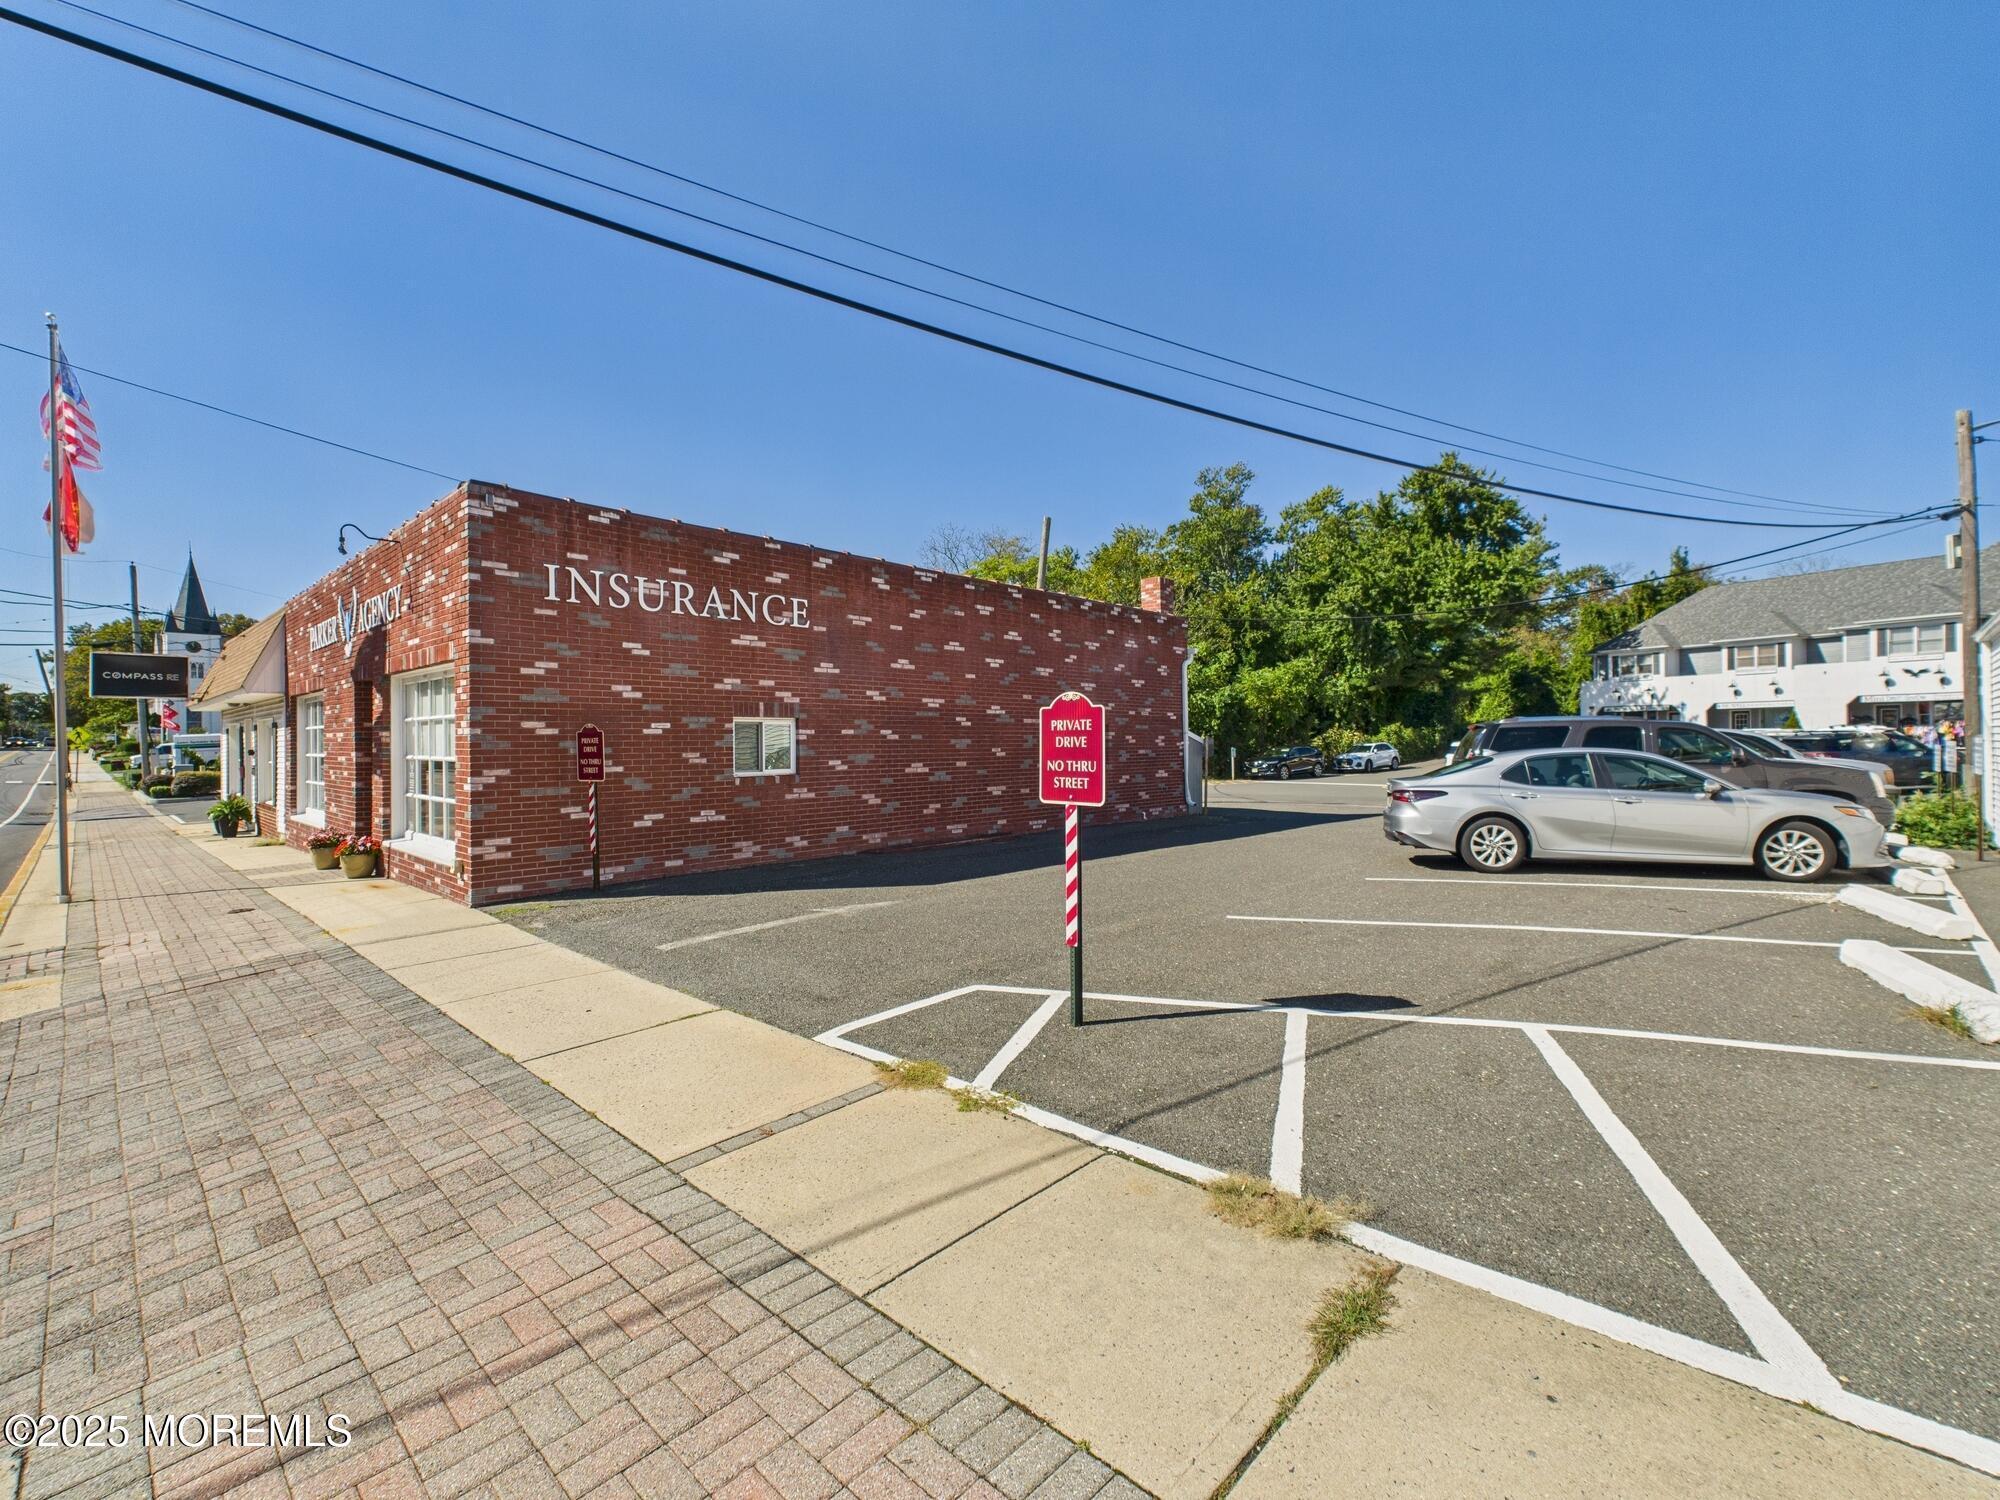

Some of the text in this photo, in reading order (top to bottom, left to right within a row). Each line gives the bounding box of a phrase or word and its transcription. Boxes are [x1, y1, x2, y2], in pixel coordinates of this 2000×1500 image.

[543, 563, 811, 629] INSURANCE
[309, 583, 403, 652] PARKER AGENCY
[102, 671, 164, 681] COMPASS
[1050, 719, 1092, 731] PRIVATE
[1055, 736, 1087, 748] DRIVE
[1046, 760, 1097, 772] NO THRU
[1053, 777, 1090, 790] STREET
